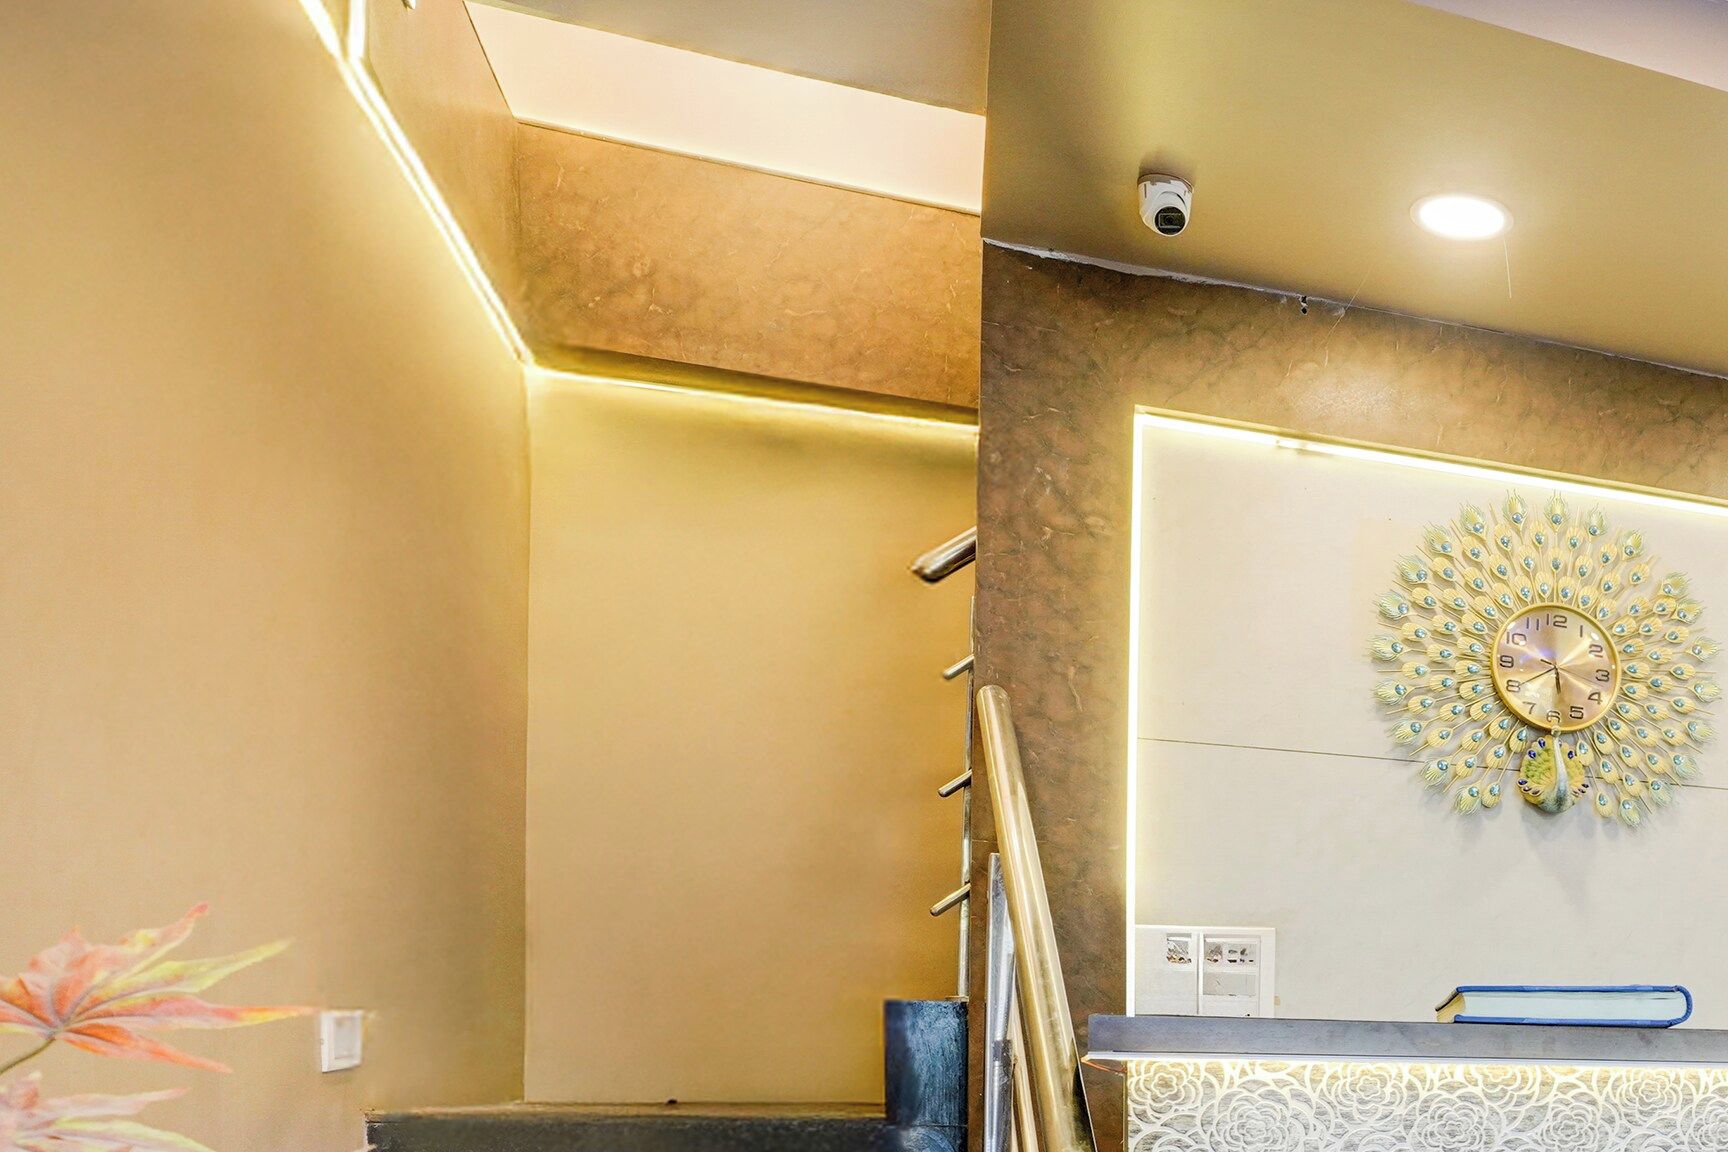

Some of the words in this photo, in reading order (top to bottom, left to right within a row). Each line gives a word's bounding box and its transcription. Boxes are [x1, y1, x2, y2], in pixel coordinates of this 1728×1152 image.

[1546, 613, 1568, 628] 12
[1506, 631, 1527, 646] 10
[1588, 643, 1604, 659] 2
[1499, 655, 1514, 669] 9
[1595, 669, 1610, 683] 3
[1506, 679, 1521, 693] 8
[1588, 691, 1603, 706] 4
[1523, 701, 1537, 715] 7
[1569, 706, 1584, 720] 5
